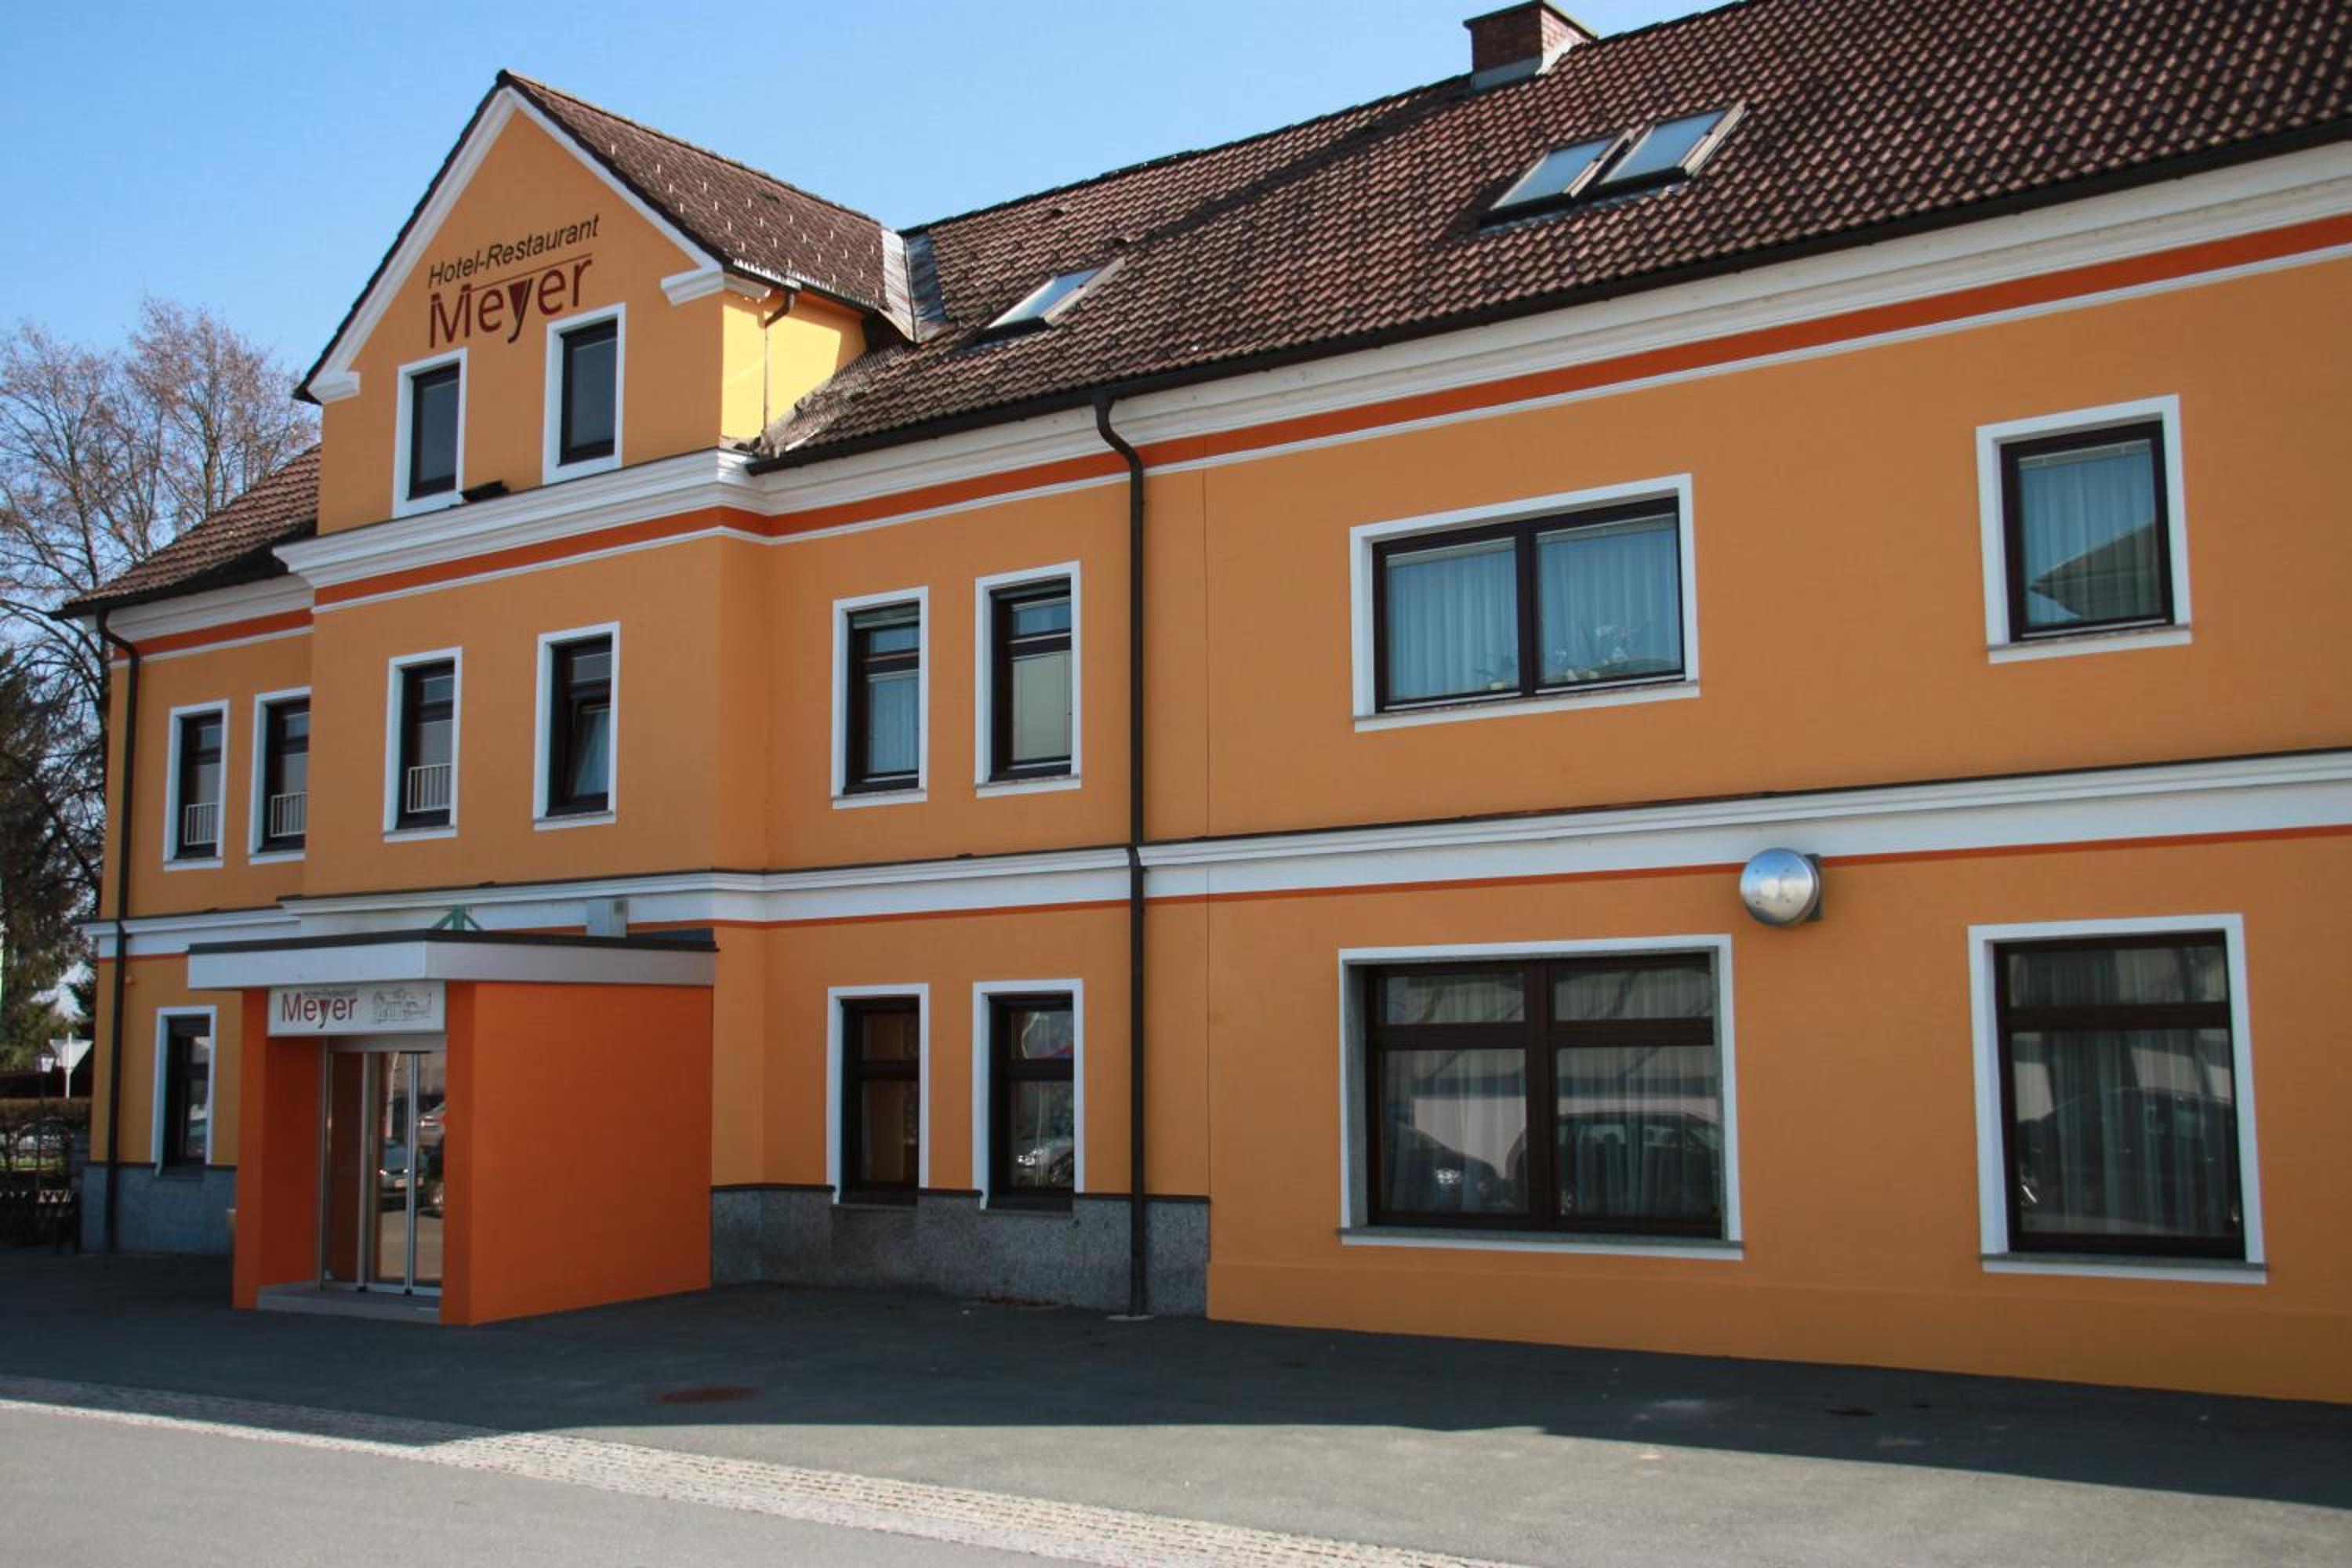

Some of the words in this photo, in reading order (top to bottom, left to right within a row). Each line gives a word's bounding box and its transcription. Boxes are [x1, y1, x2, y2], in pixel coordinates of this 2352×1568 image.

[428, 213, 599, 289] Hotel-Restaurant
[430, 259, 593, 348] Meyer
[281, 992, 358, 1029] Meyer
